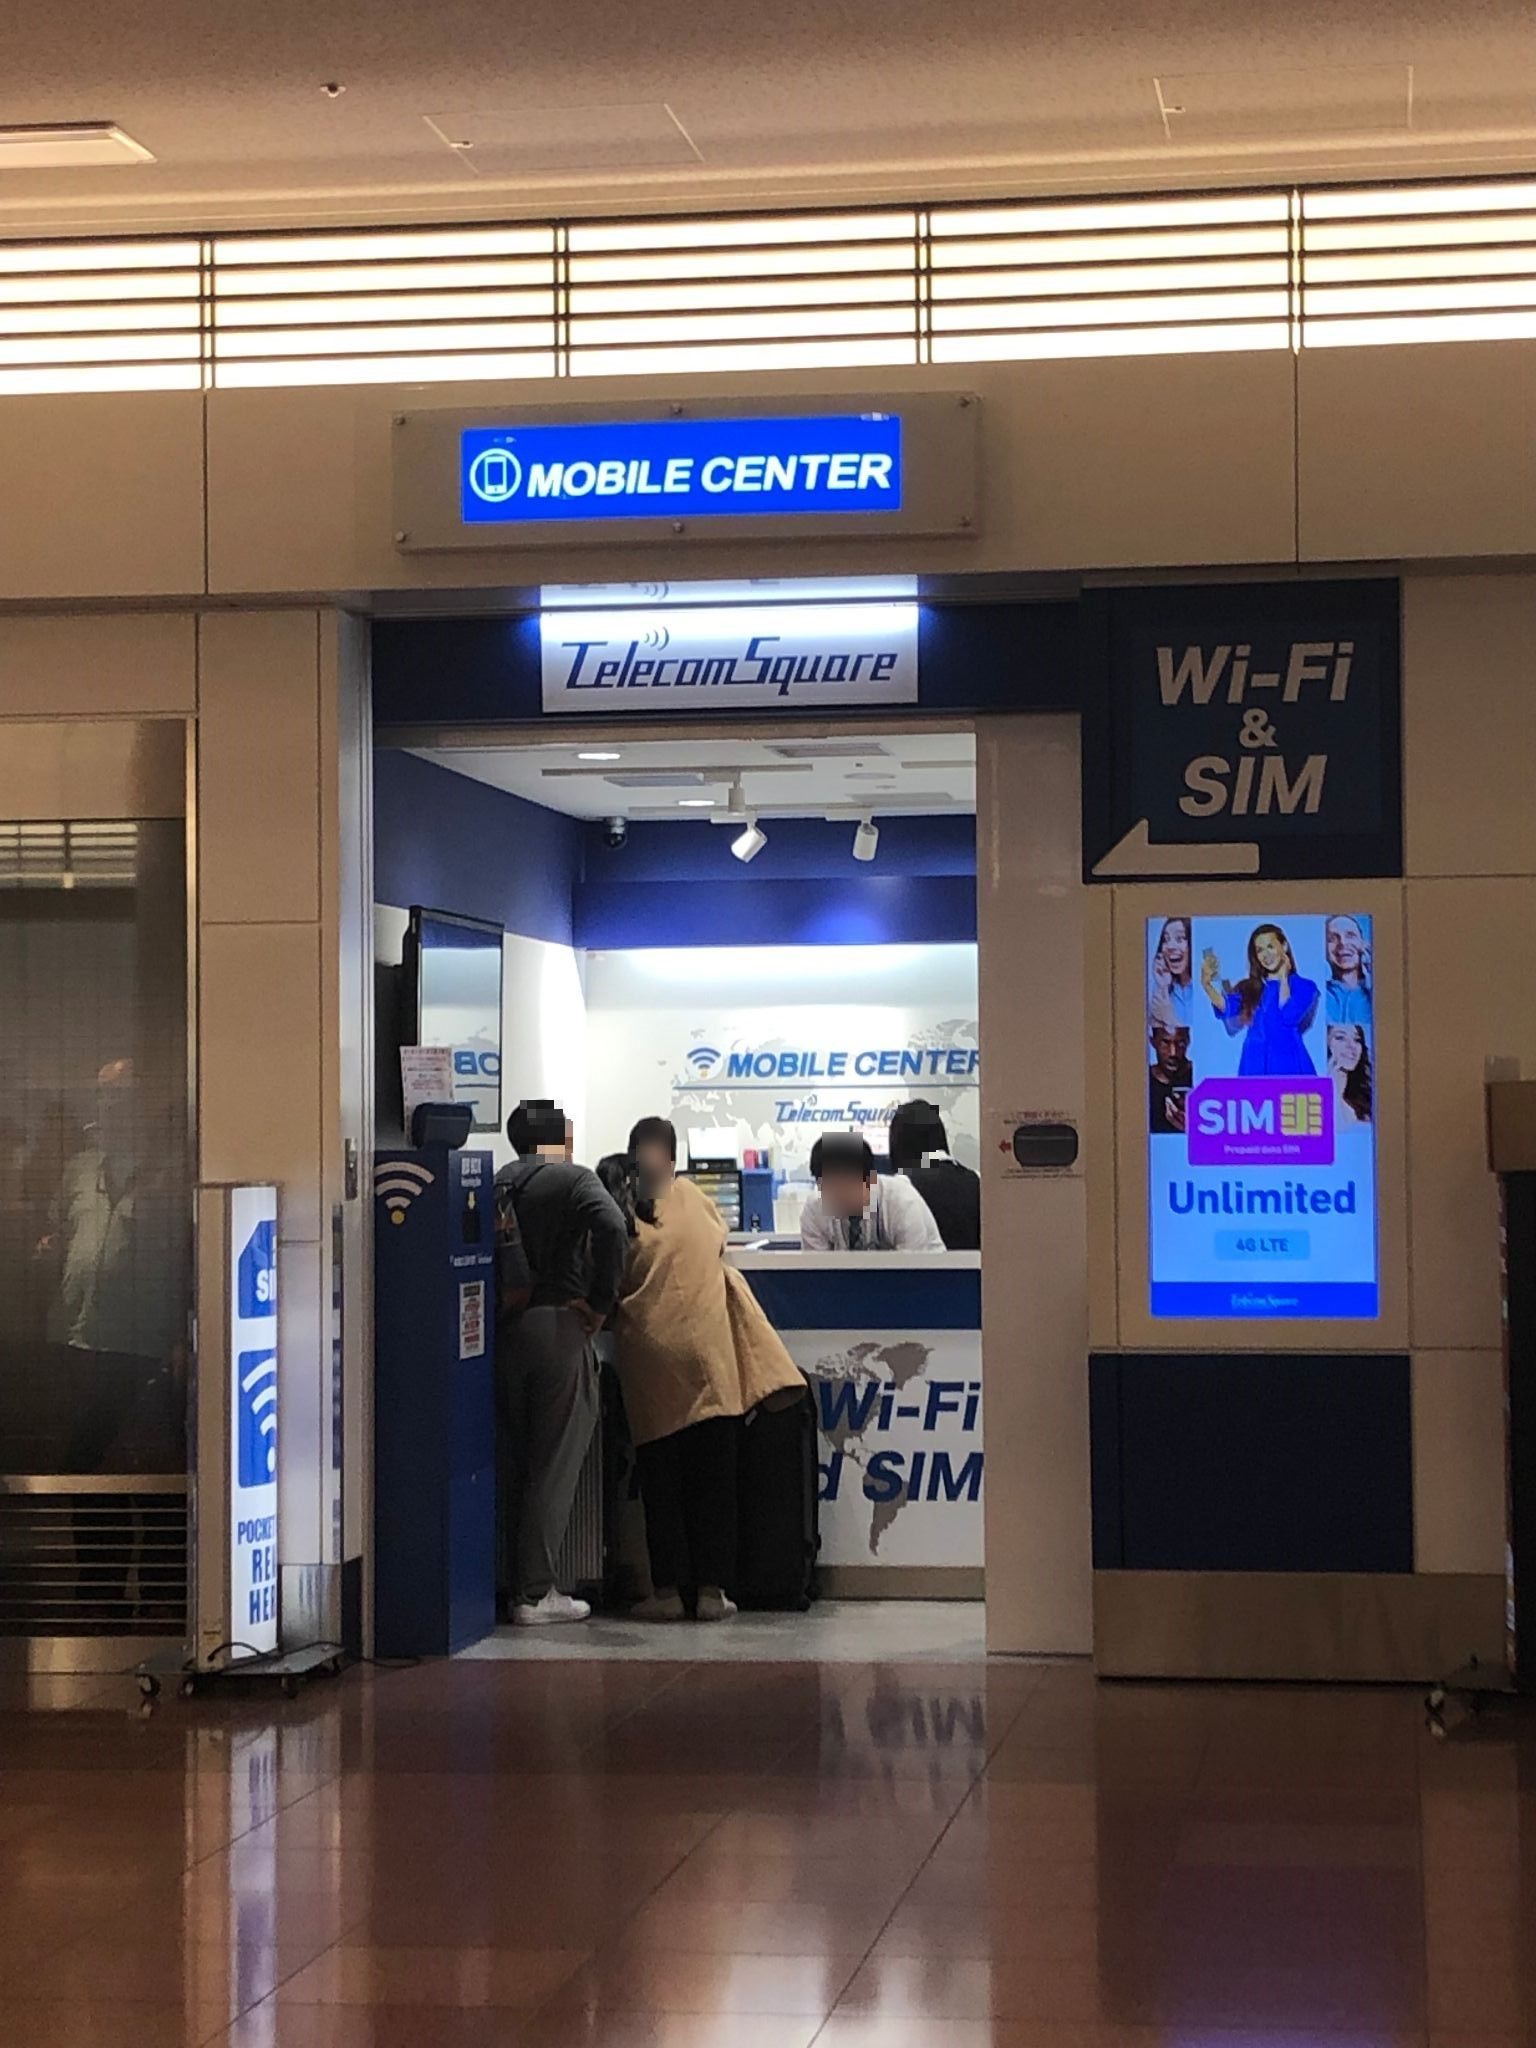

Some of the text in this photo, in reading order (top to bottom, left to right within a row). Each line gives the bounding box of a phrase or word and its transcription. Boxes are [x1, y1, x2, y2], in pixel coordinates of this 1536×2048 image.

[527, 453, 892, 498] MOBILE CENTER
[1156, 641, 1354, 705] Wi-Fi
[1238, 707, 1278, 749] &
[1178, 754, 1328, 817] SIM
[726, 1050, 848, 1078] MOBILE
[1197, 1098, 1275, 1136] SIM
[1168, 1180, 1356, 1215] Unlimited
[1259, 1237, 1289, 1252] LTE
[819, 1380, 981, 1432] Wi-Fi
[863, 1451, 984, 1503] SIM
